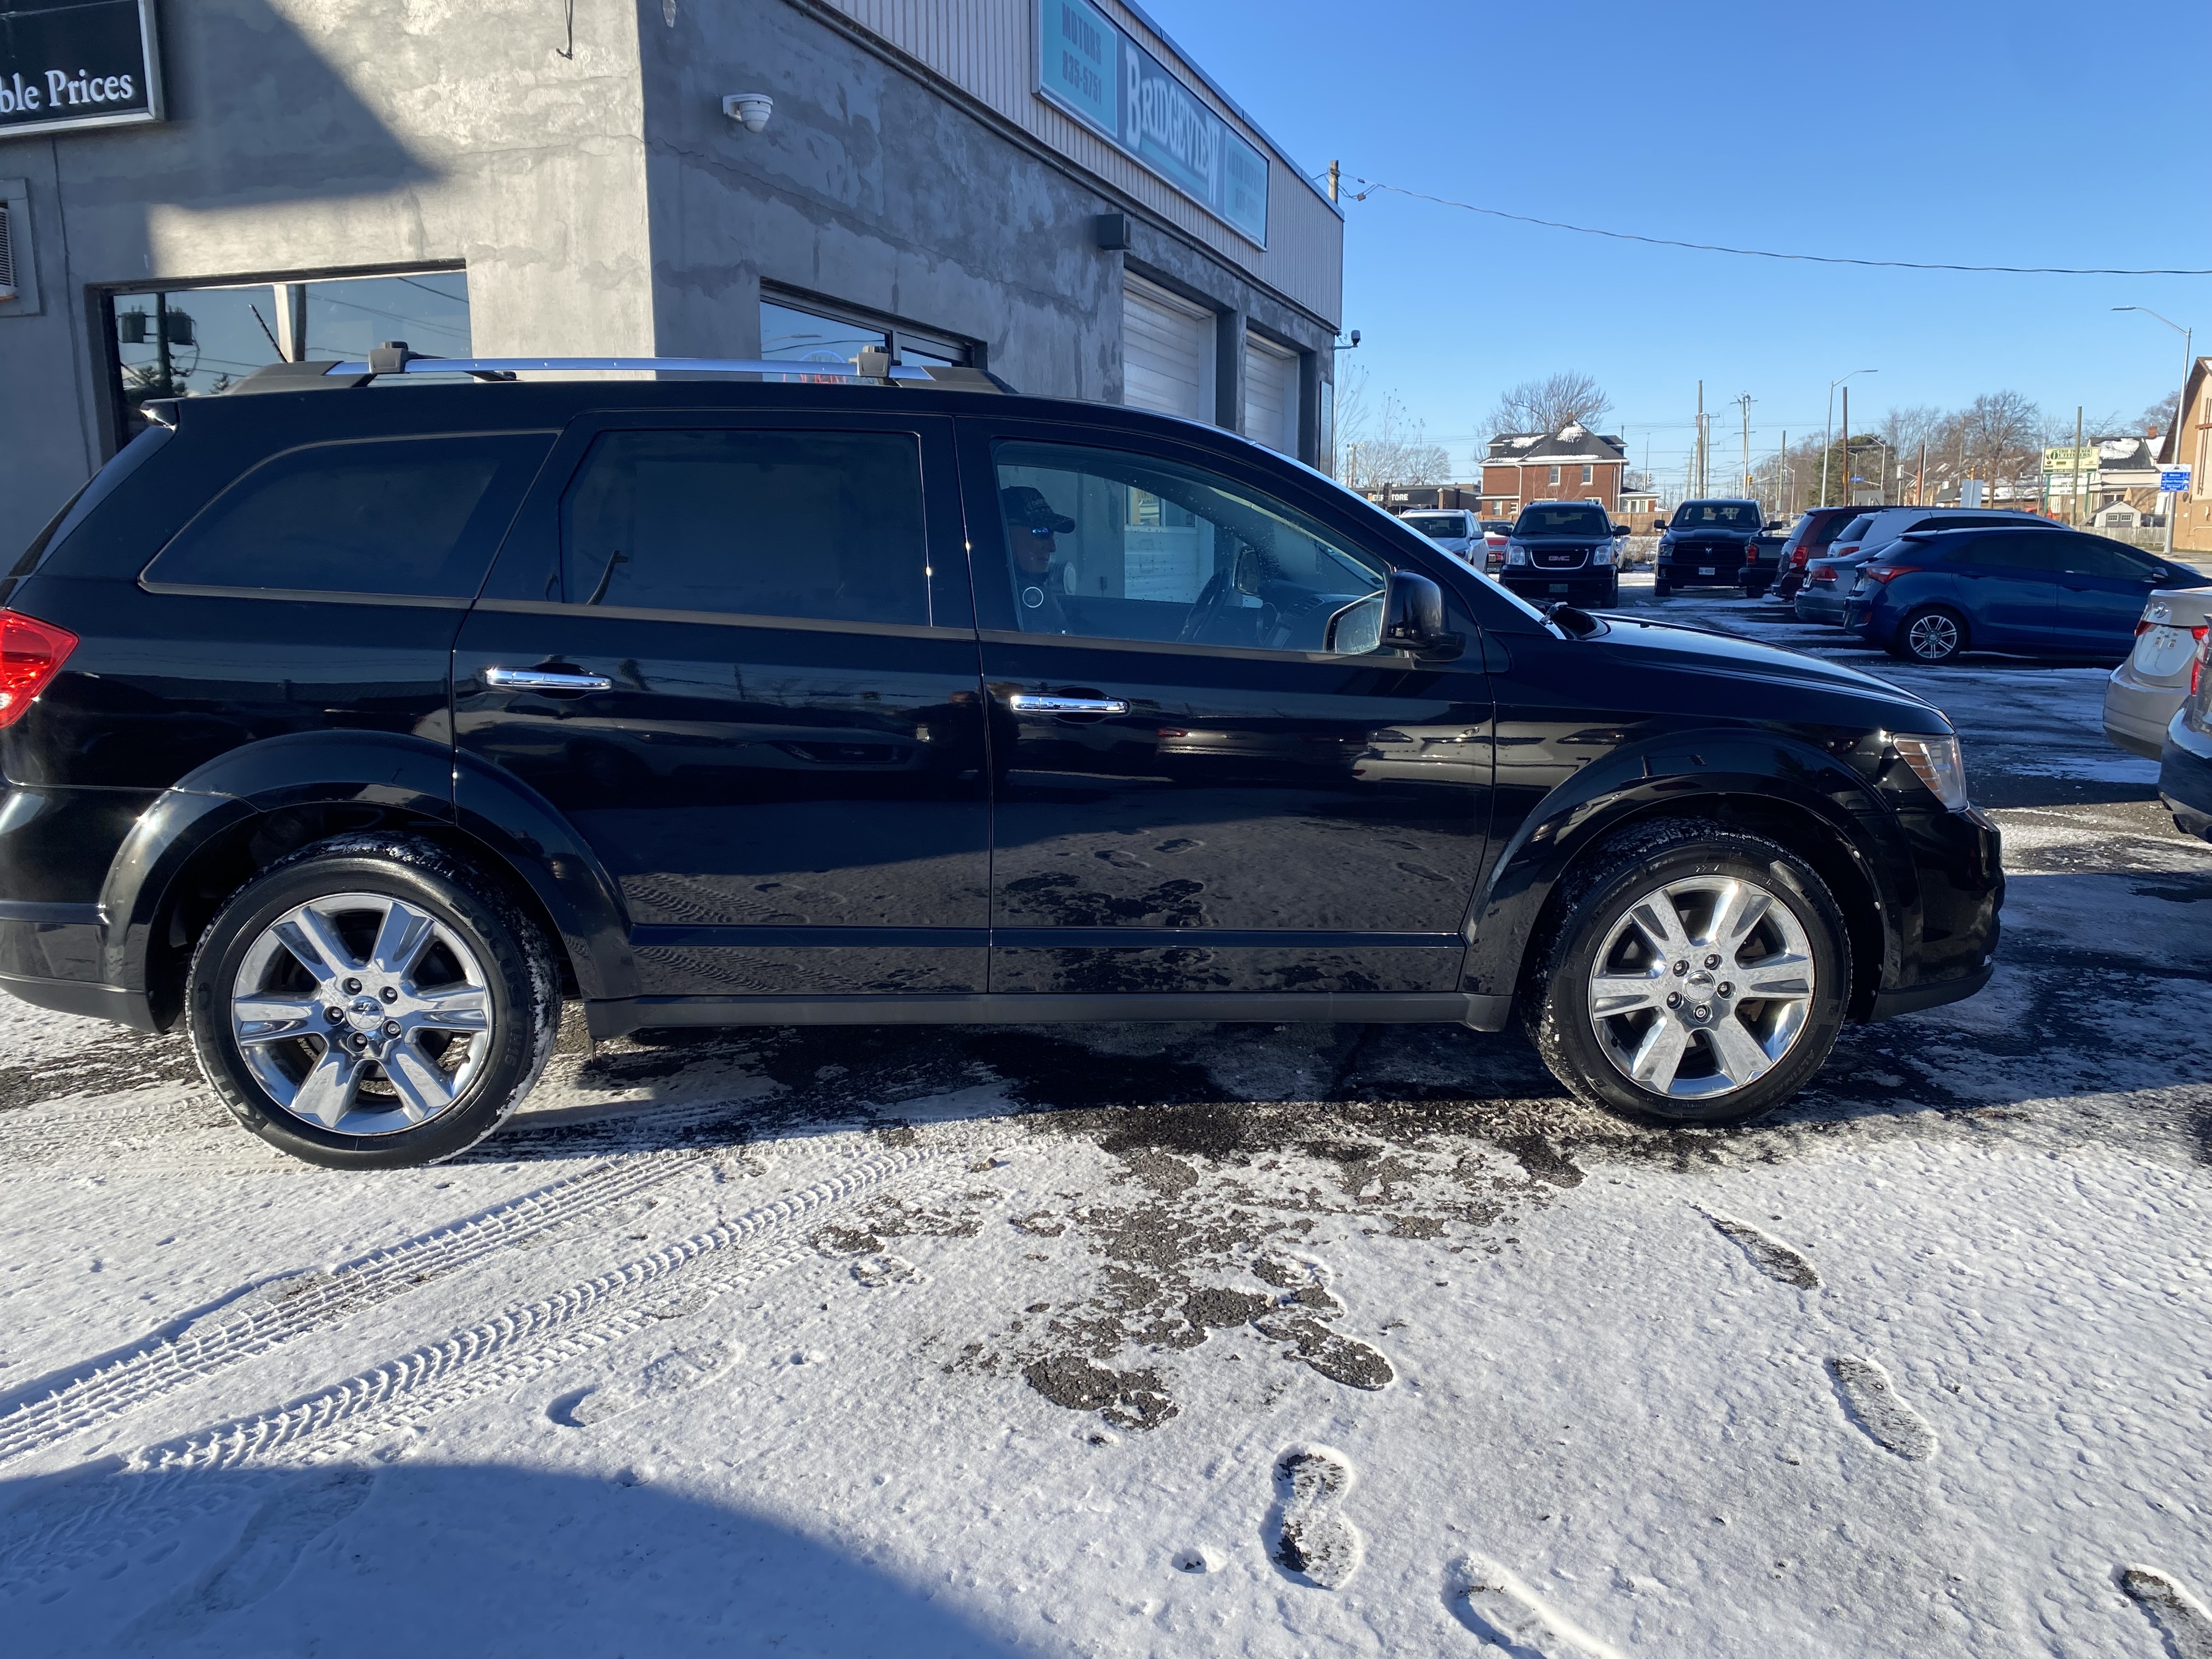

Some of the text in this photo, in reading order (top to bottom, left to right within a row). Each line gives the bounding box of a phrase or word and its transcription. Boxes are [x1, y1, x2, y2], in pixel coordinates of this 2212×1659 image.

[1062, 1, 1101, 65] MOTORS
[44, 69, 133, 107] Prices
[1062, 49, 1102, 106] 835-5751
[1126, 42, 1221, 207] BRIDGEVIEW
[1227, 148, 1243, 182] AUTO
[447, 894, 523, 1068] SOLUS KH16
[1765, 1048, 1816, 1101] ALTIMAX
